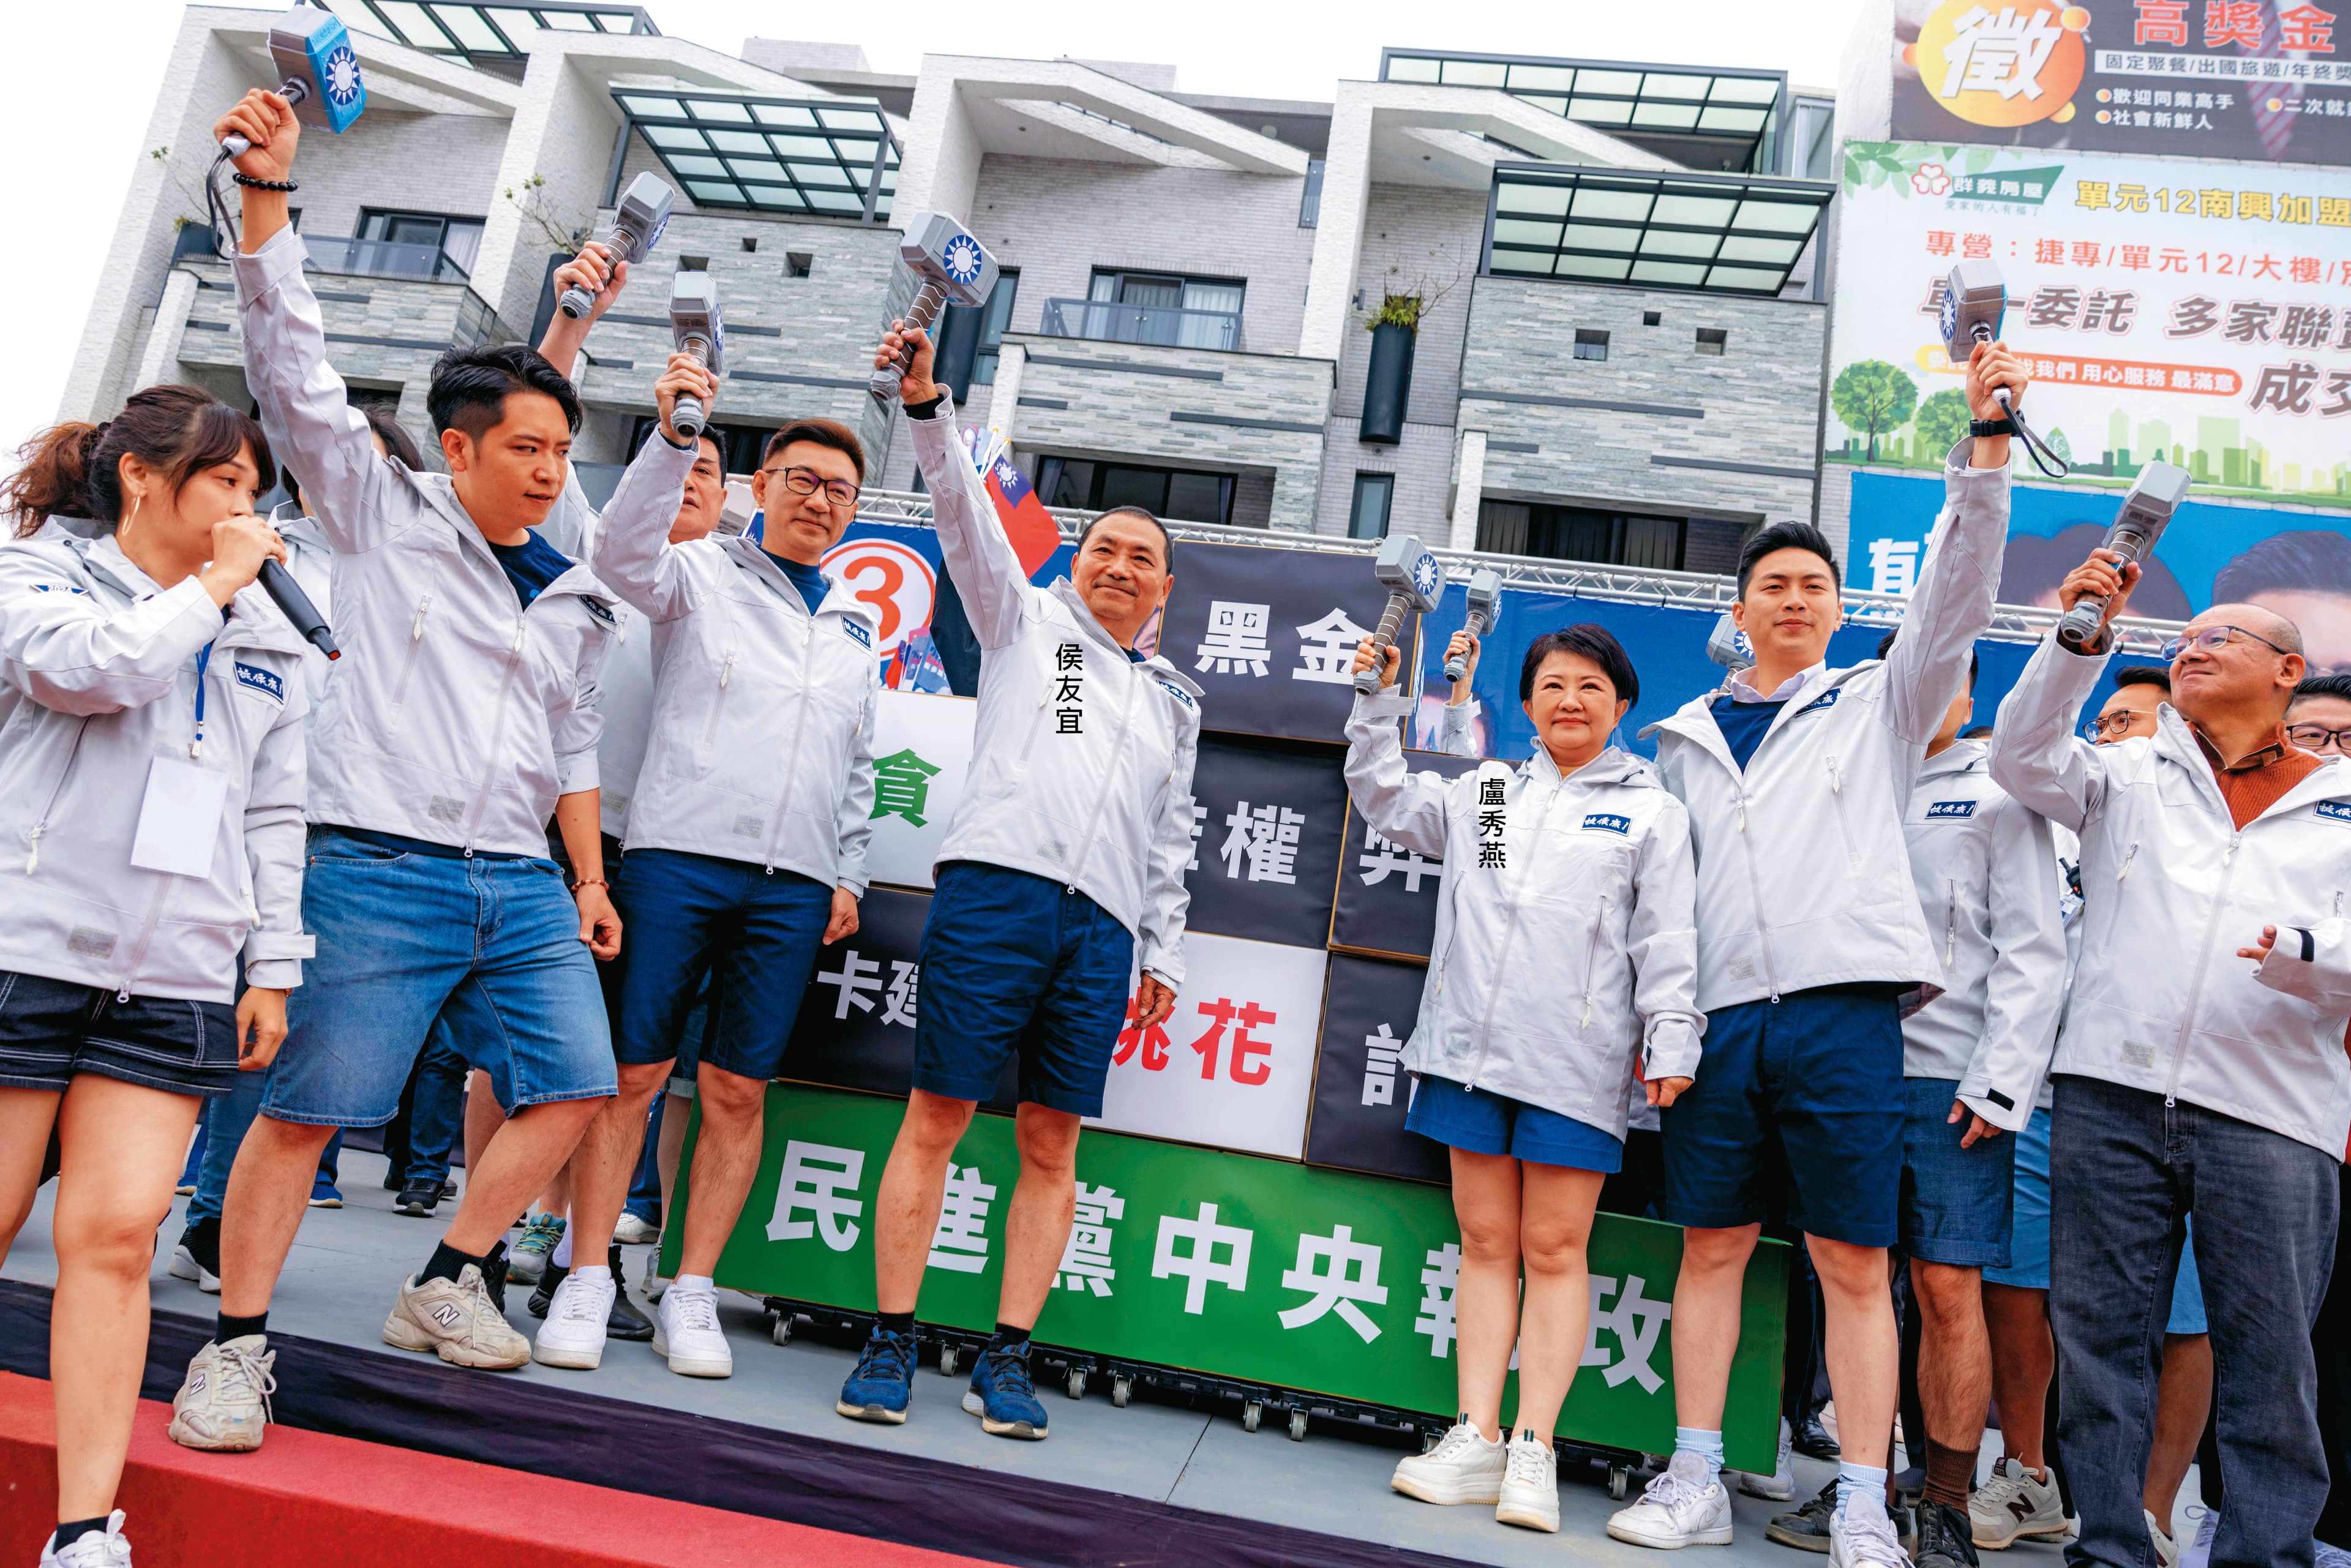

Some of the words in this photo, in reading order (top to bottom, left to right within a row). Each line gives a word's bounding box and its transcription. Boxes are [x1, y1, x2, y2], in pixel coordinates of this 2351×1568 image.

[2134, 0, 2337, 53] 高獎金
[1940, 5, 2063, 101] 徵
[2113, 88, 2234, 110] 歡迎同業高手
[2113, 109, 2214, 130] 社會新鮮人
[2284, 97, 2351, 117] 二次就
[1953, 176, 2044, 199] 群義房屋
[2075, 180, 2351, 227] 單元12南興加盟
[2082, 364, 2166, 386] 用心服務
[2171, 370, 2236, 393] 最滿意
[844, 556, 904, 642] 3
[1194, 600, 1374, 685] 黑金
[868, 748, 942, 828] 貪
[1185, 795, 1305, 885] 權
